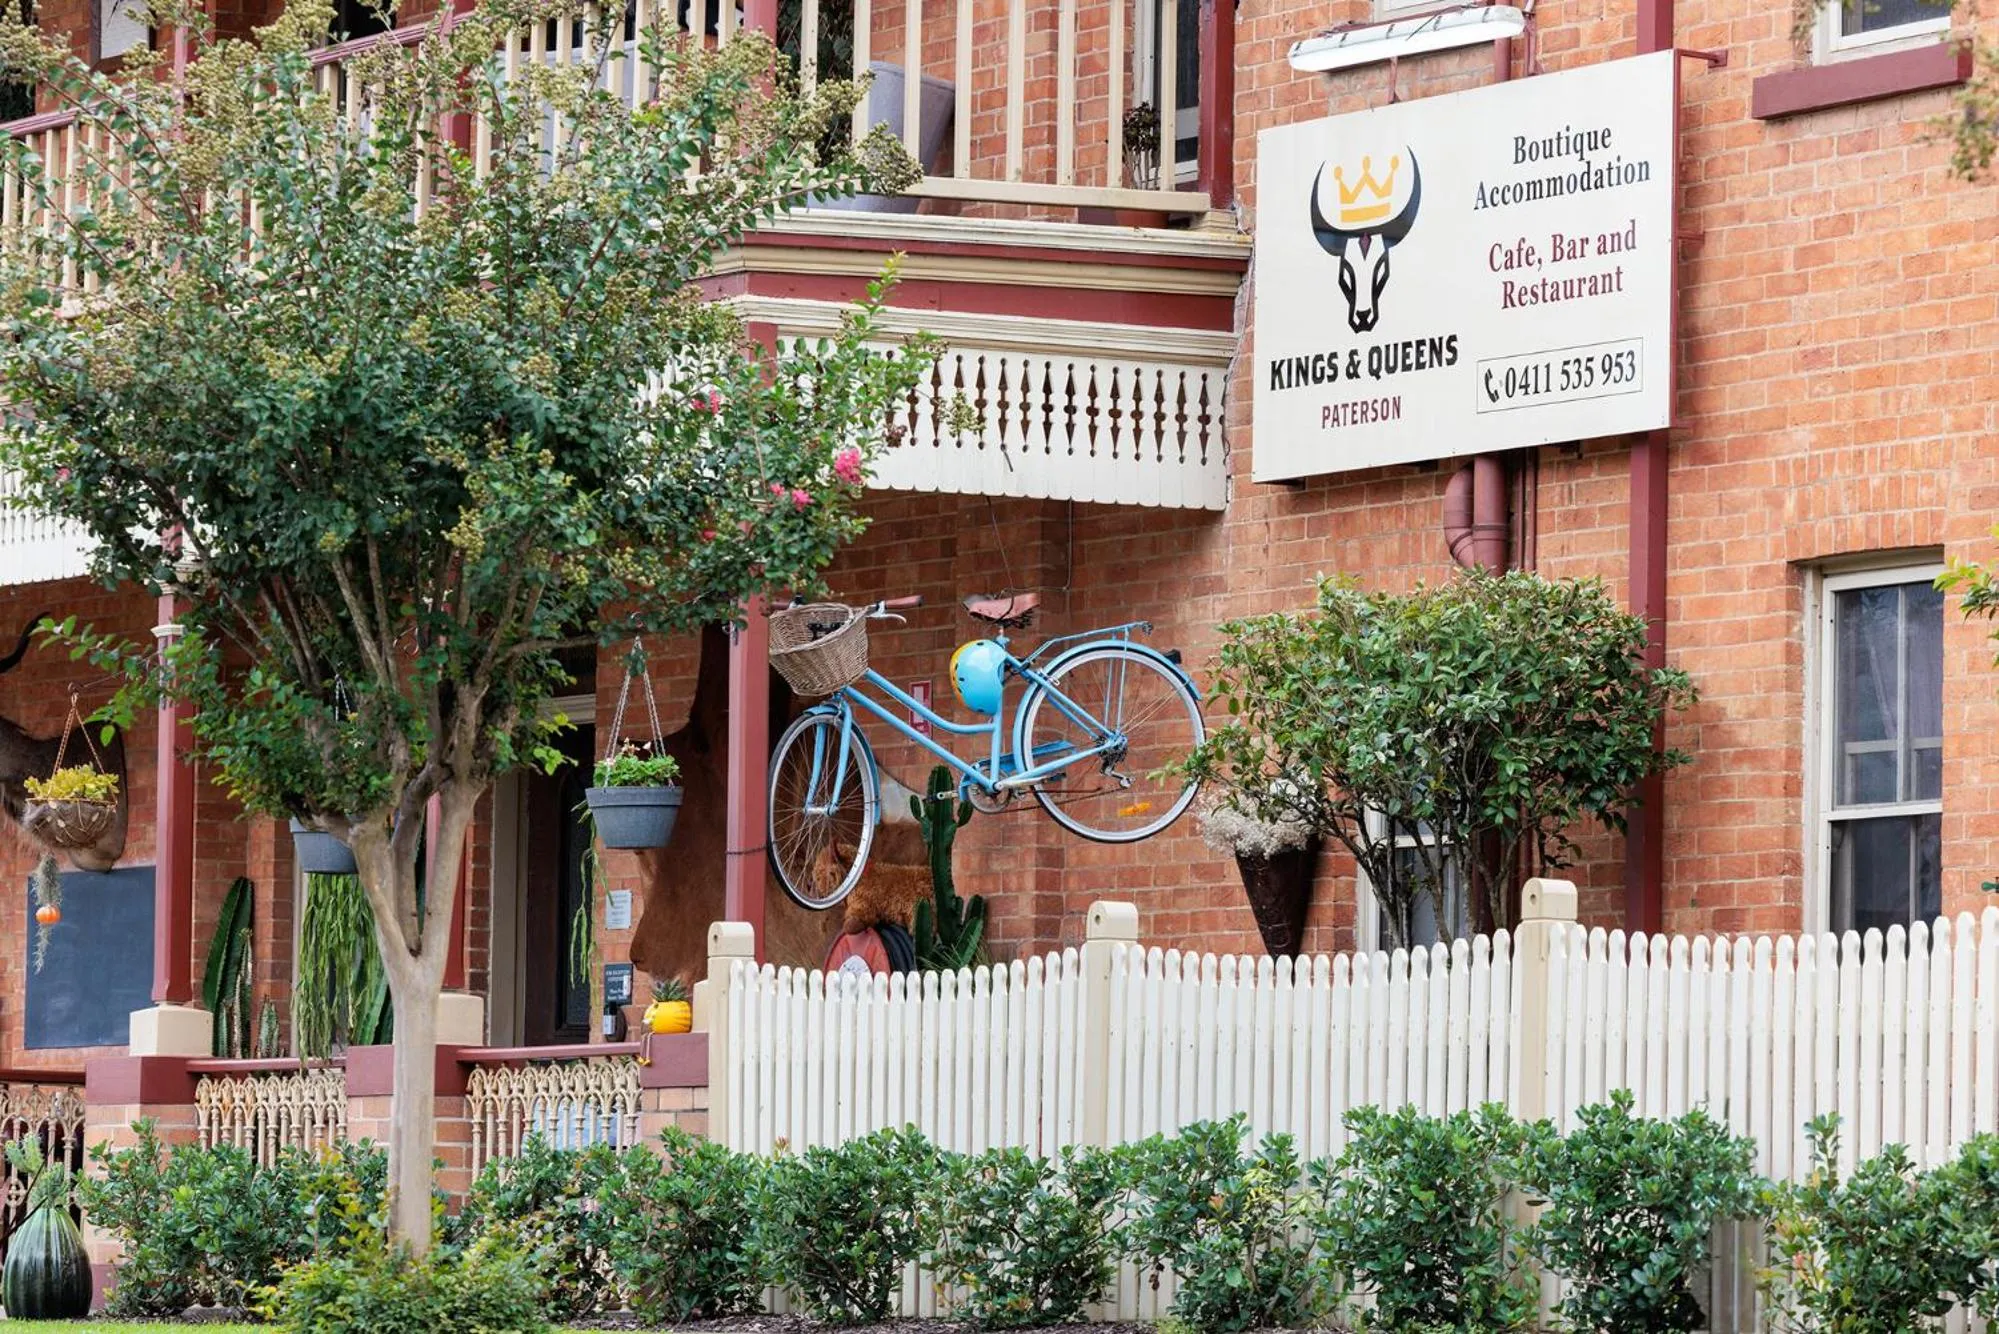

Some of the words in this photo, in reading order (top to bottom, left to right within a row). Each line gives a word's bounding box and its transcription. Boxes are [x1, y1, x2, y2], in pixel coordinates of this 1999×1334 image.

[1513, 125, 1612, 164] Boutique
[1474, 155, 1650, 210] Accommodation
[1489, 237, 1543, 272] Cafe,
[1551, 234, 1589, 263] Bar
[1597, 219, 1637, 256] and
[1501, 266, 1623, 310] Restaurant
[1270, 351, 1339, 391] KINGS
[1345, 349, 1361, 380] &
[1368, 334, 1459, 381] QUEENS
[1505, 362, 1551, 398] 0411
[1560, 356, 1595, 391] 535
[1601, 350, 1636, 385] 953
[1321, 396, 1402, 430] PATERSON
